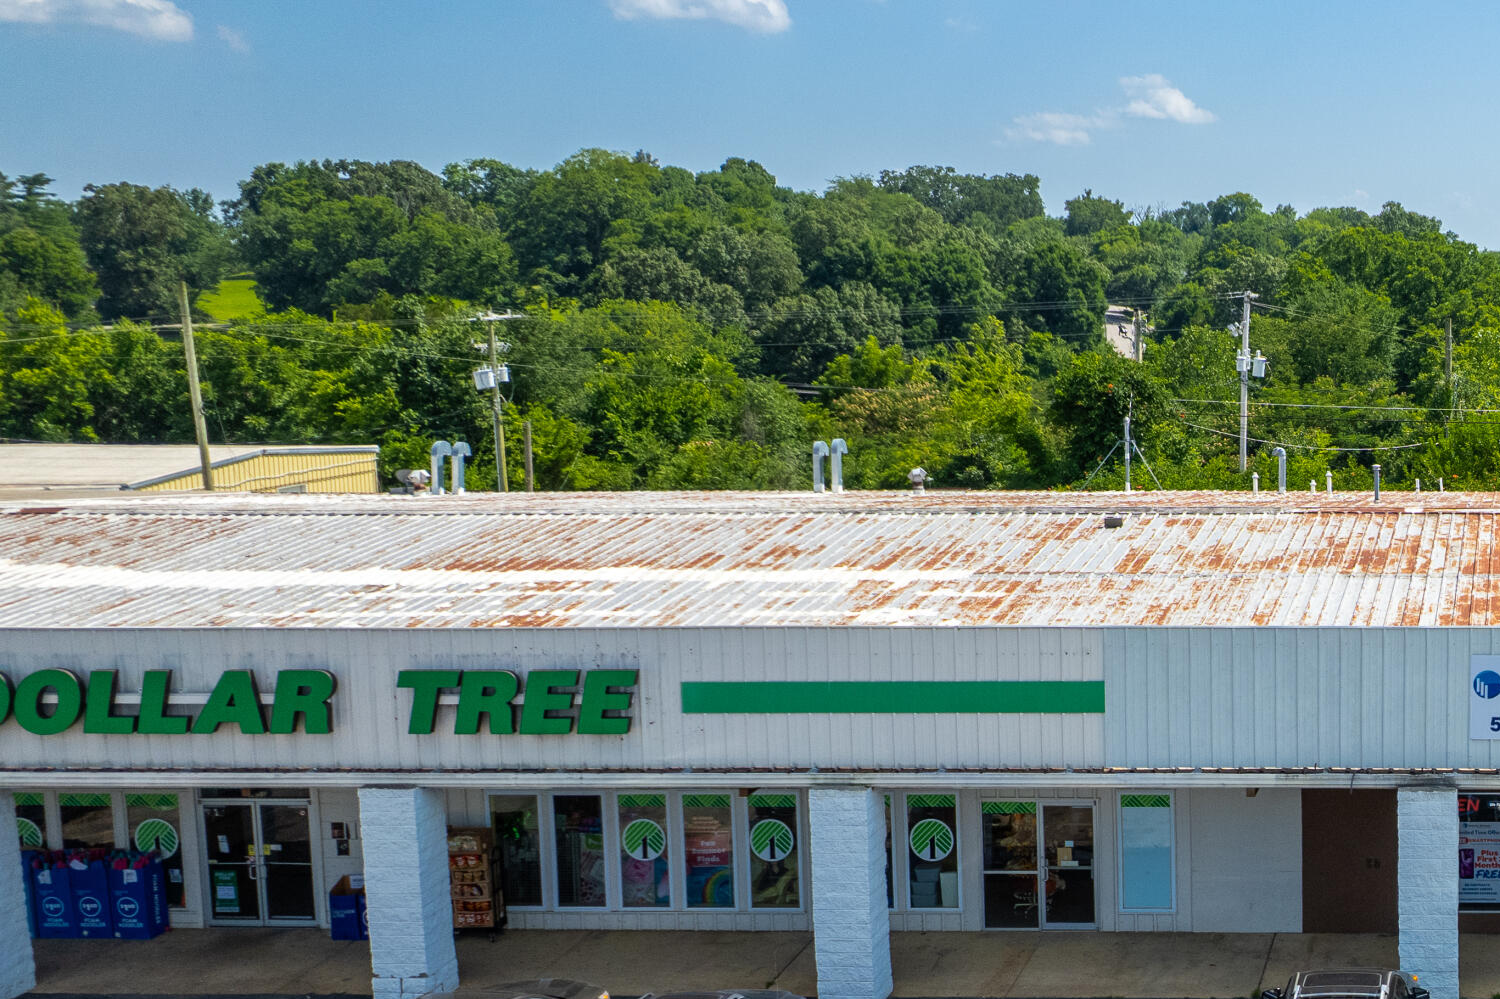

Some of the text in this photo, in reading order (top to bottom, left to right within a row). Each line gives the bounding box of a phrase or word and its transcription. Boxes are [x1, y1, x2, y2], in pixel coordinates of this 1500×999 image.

[0, 668, 640, 735] OLLAR TREE
[1458, 798, 1480, 812] EN
